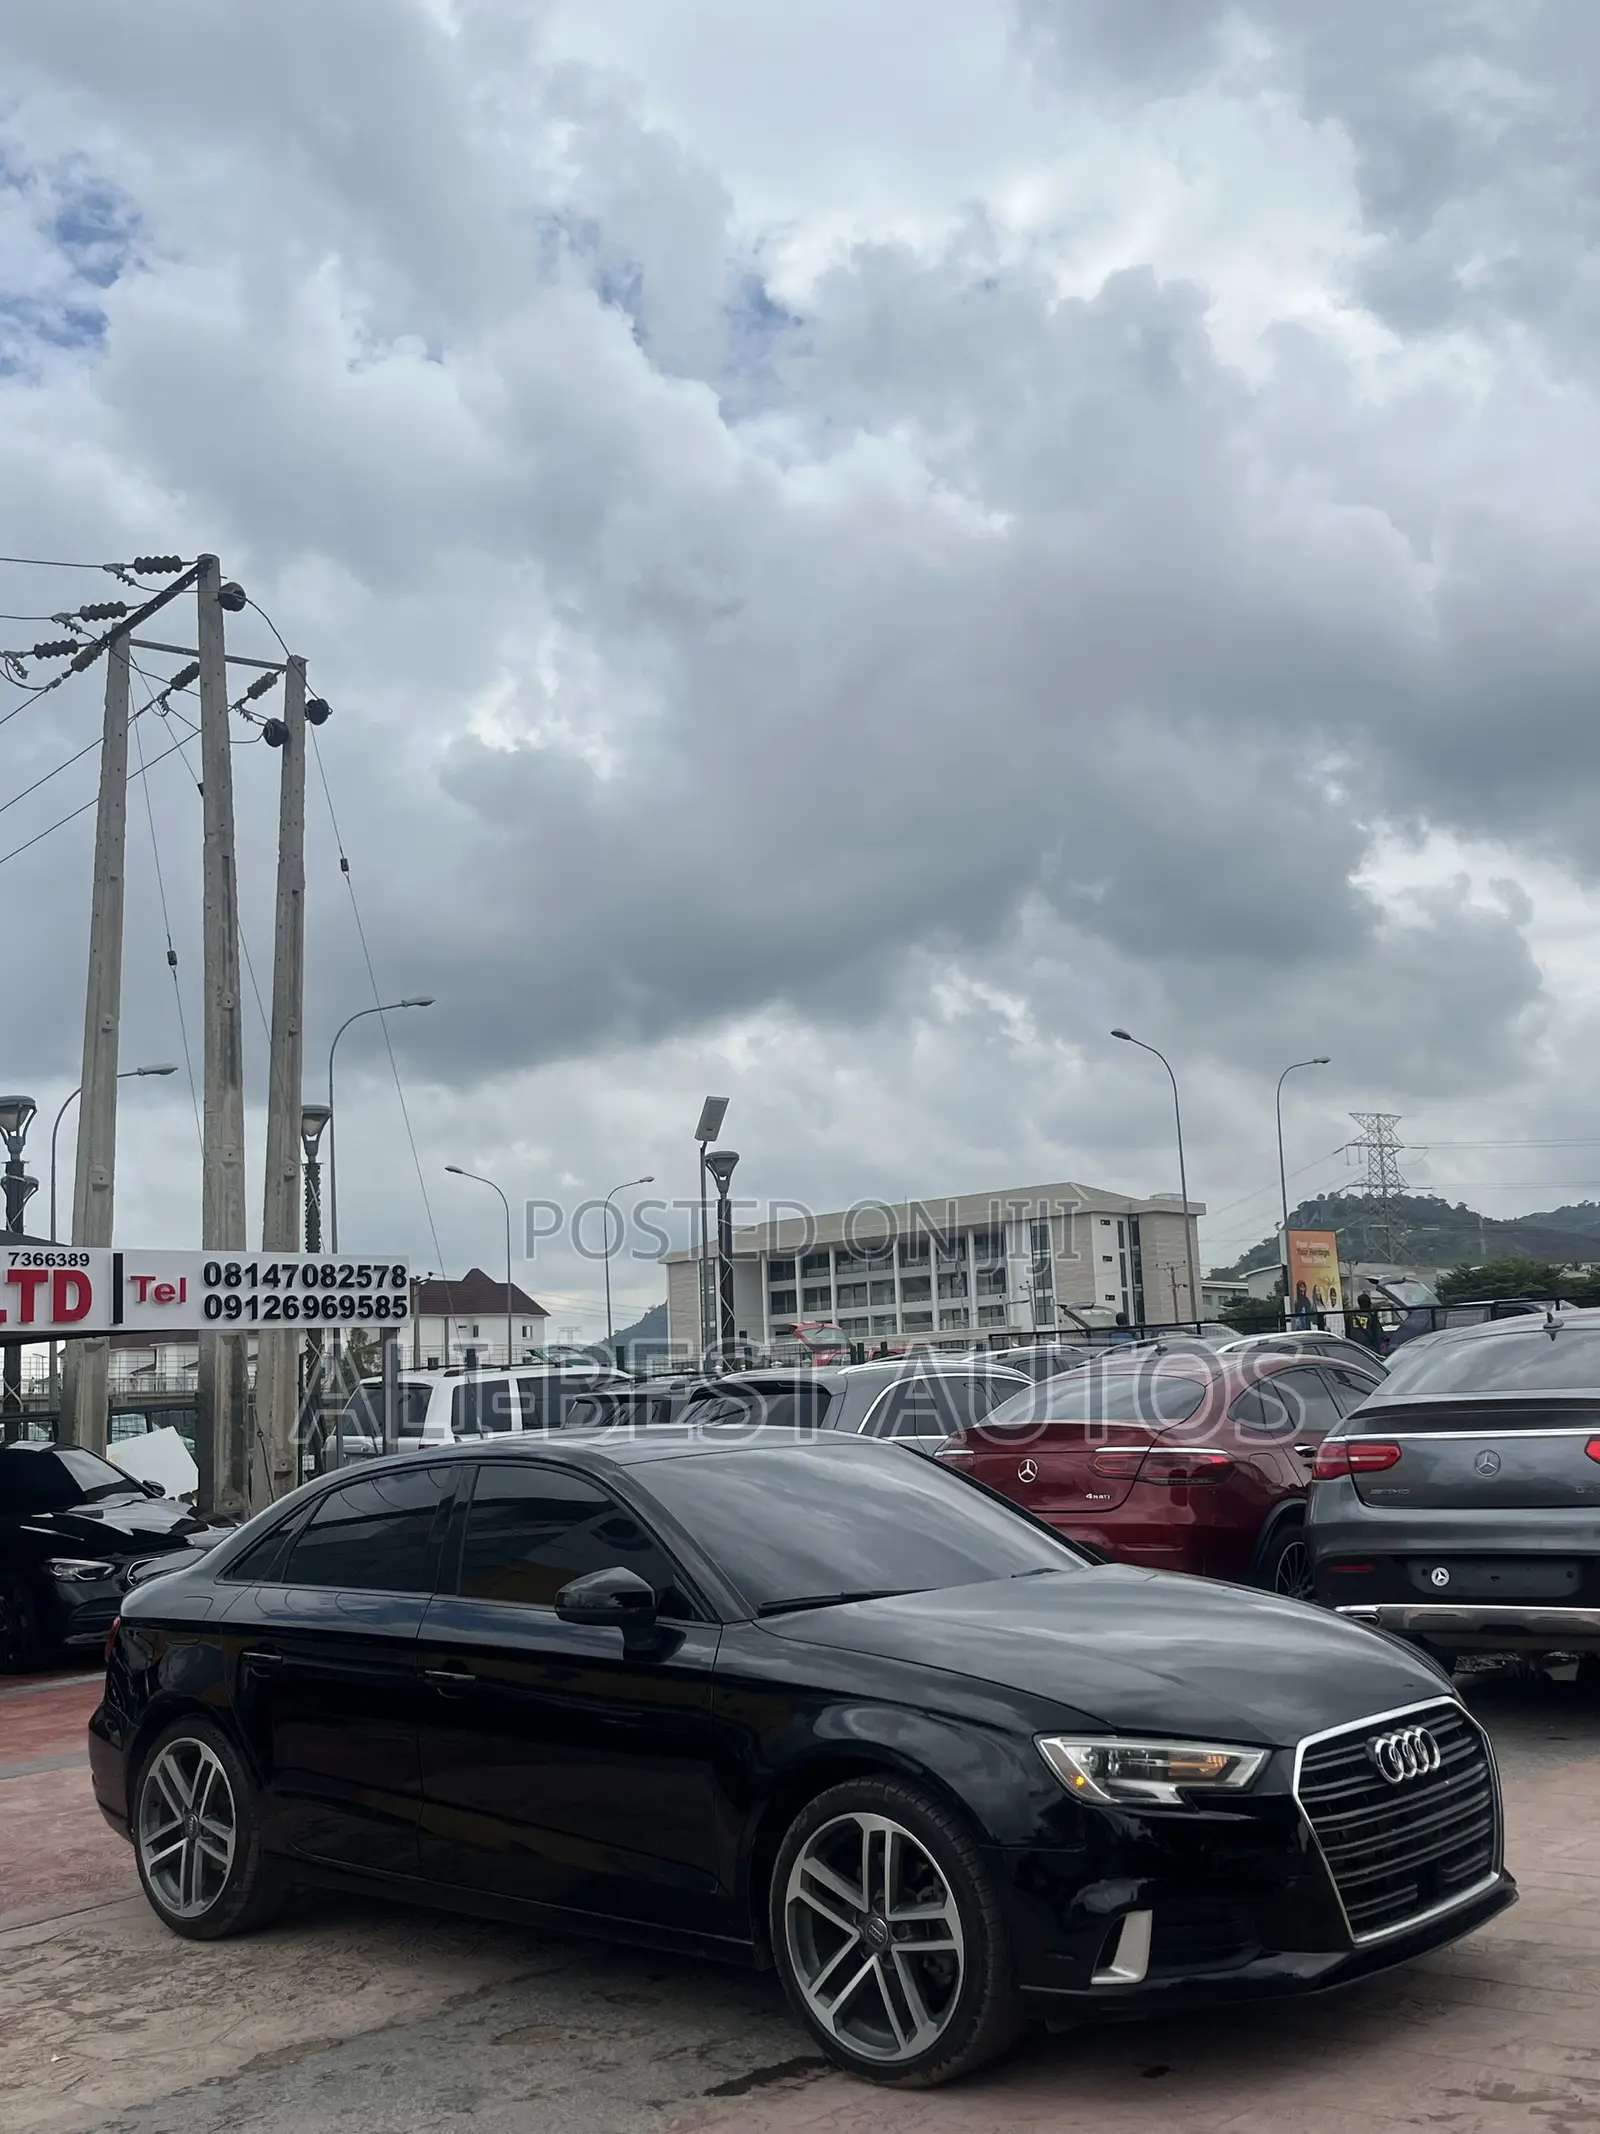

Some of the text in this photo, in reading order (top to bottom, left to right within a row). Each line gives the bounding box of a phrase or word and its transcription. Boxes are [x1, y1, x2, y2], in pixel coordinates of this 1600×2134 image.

[8, 1252, 90, 1267] 7366389
[203, 1261, 407, 1288] 08147082578
[130, 1275, 187, 1304] Tel
[204, 1294, 408, 1321] 09126969585
